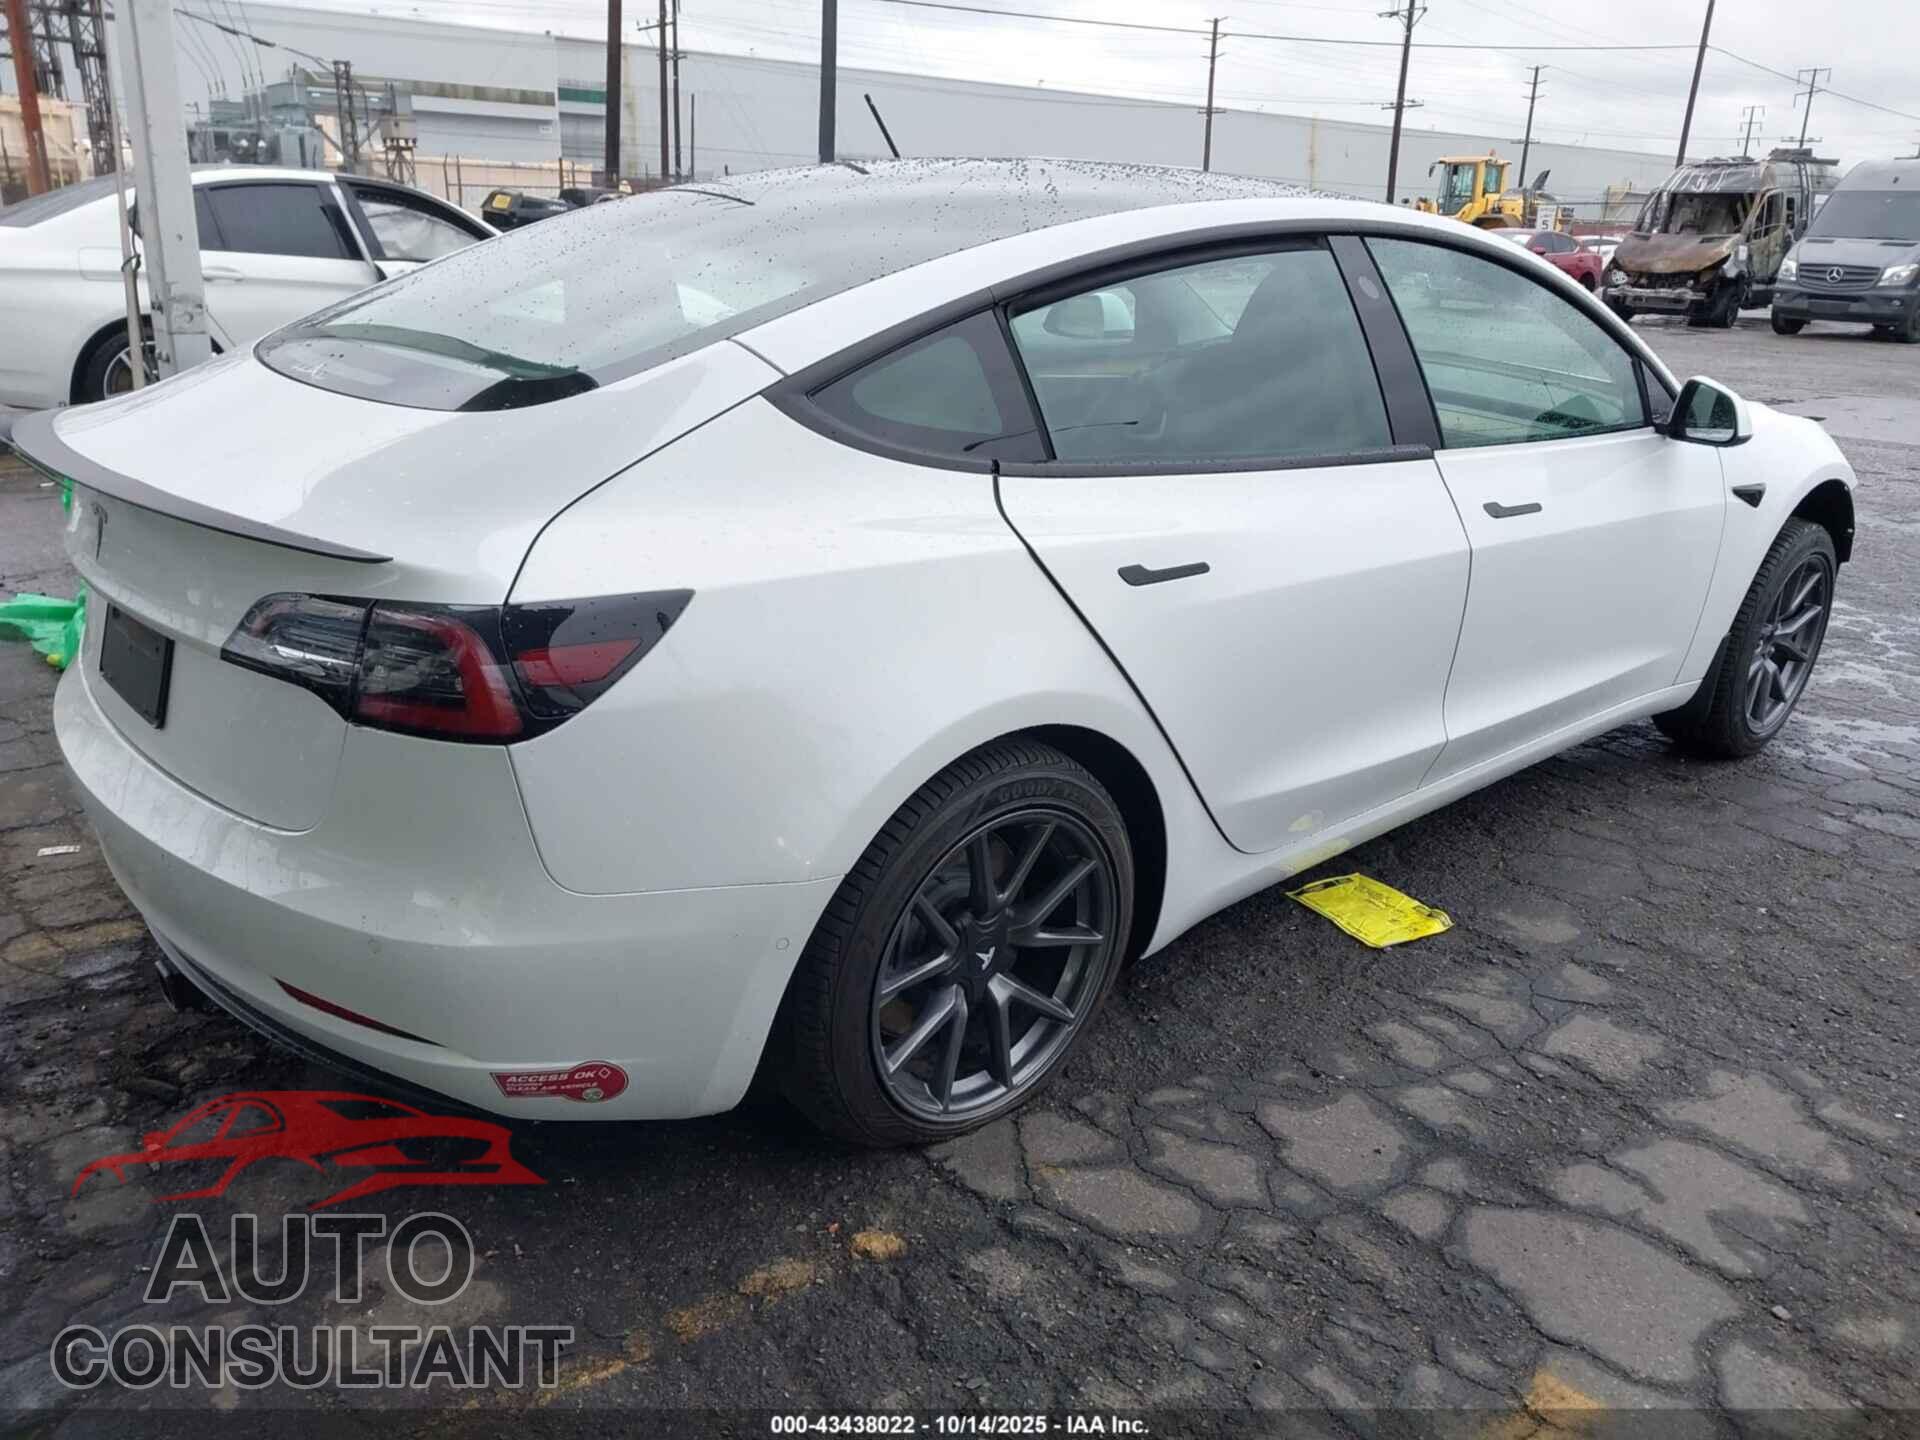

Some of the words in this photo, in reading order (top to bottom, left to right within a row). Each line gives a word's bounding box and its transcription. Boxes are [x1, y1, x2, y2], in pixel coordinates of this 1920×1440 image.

[1542, 219, 1549, 230] 5
[506, 1073, 568, 1083] ACCESS
[574, 1070, 595, 1079] OK
